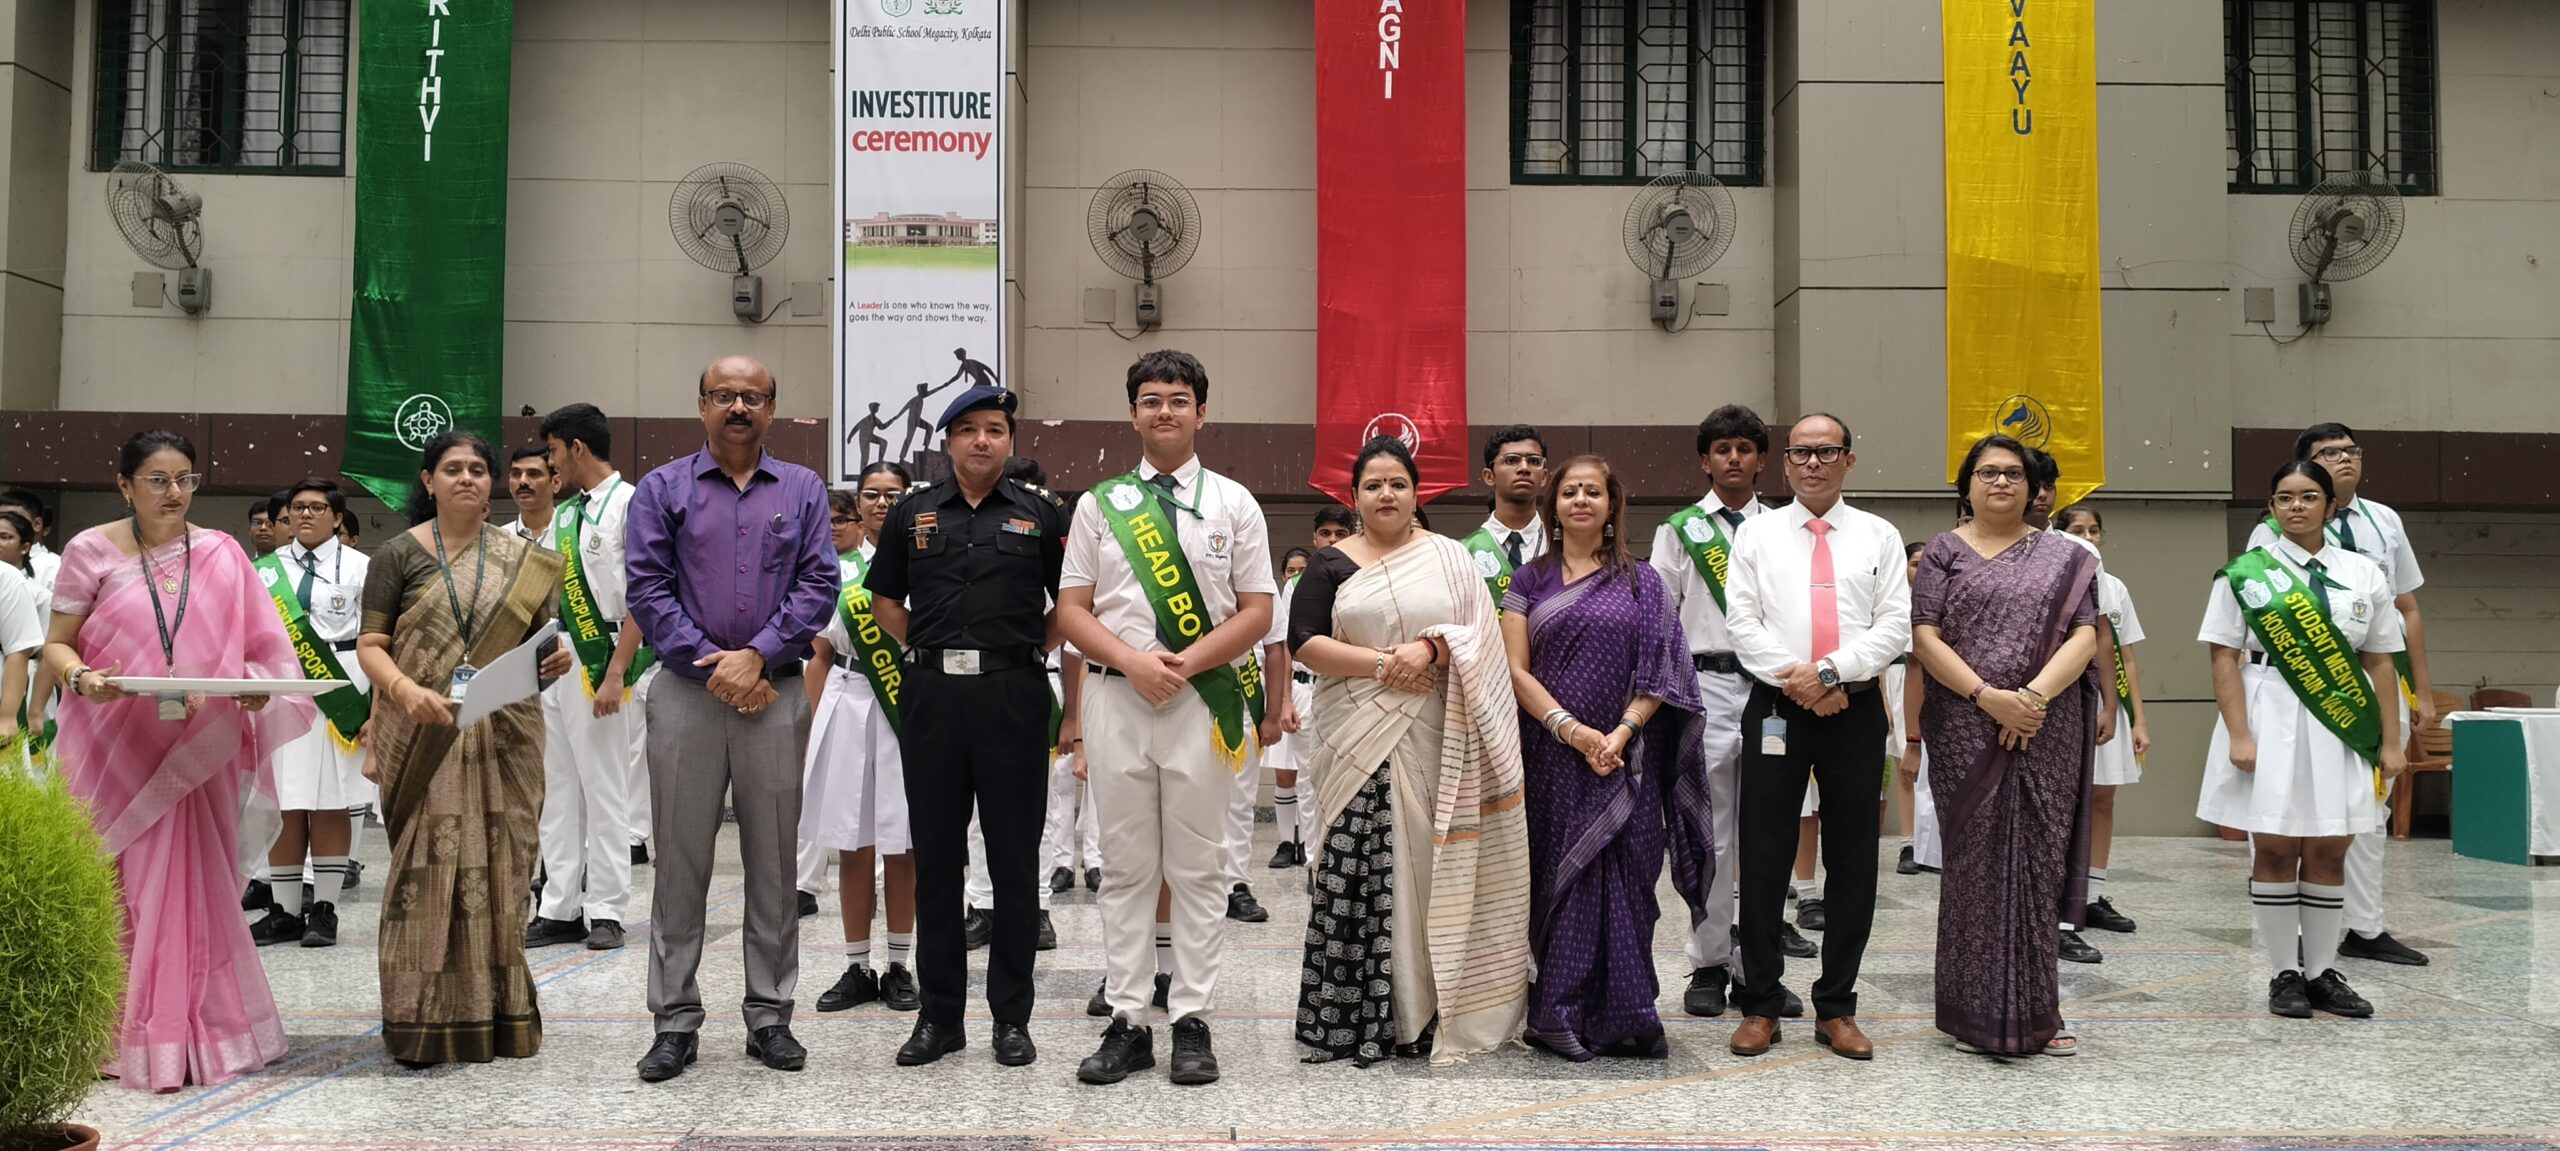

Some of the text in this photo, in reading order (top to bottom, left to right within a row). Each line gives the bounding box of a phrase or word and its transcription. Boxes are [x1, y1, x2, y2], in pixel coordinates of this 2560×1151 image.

[850, 25, 992, 42] Delhi Public School Megacity, Kolkata
[2008, 0, 2032, 135] VAAYU
[852, 90, 991, 119] INVESTITURE
[852, 130, 992, 161] ceremony
[849, 301, 992, 312] A Leader is one who knows the way,
[849, 313, 987, 324] goes the way and shows the way.
[1128, 512, 1204, 640] HEAD BO
[565, 577, 599, 641] DISCIPLINE
[843, 583, 881, 645] HEAD
[2284, 592, 2339, 653] STUDENT
[2260, 610, 2296, 652] HOUSE
[2283, 648, 2327, 695] CAPTAIN
[2320, 692, 2357, 729] VAAYU
